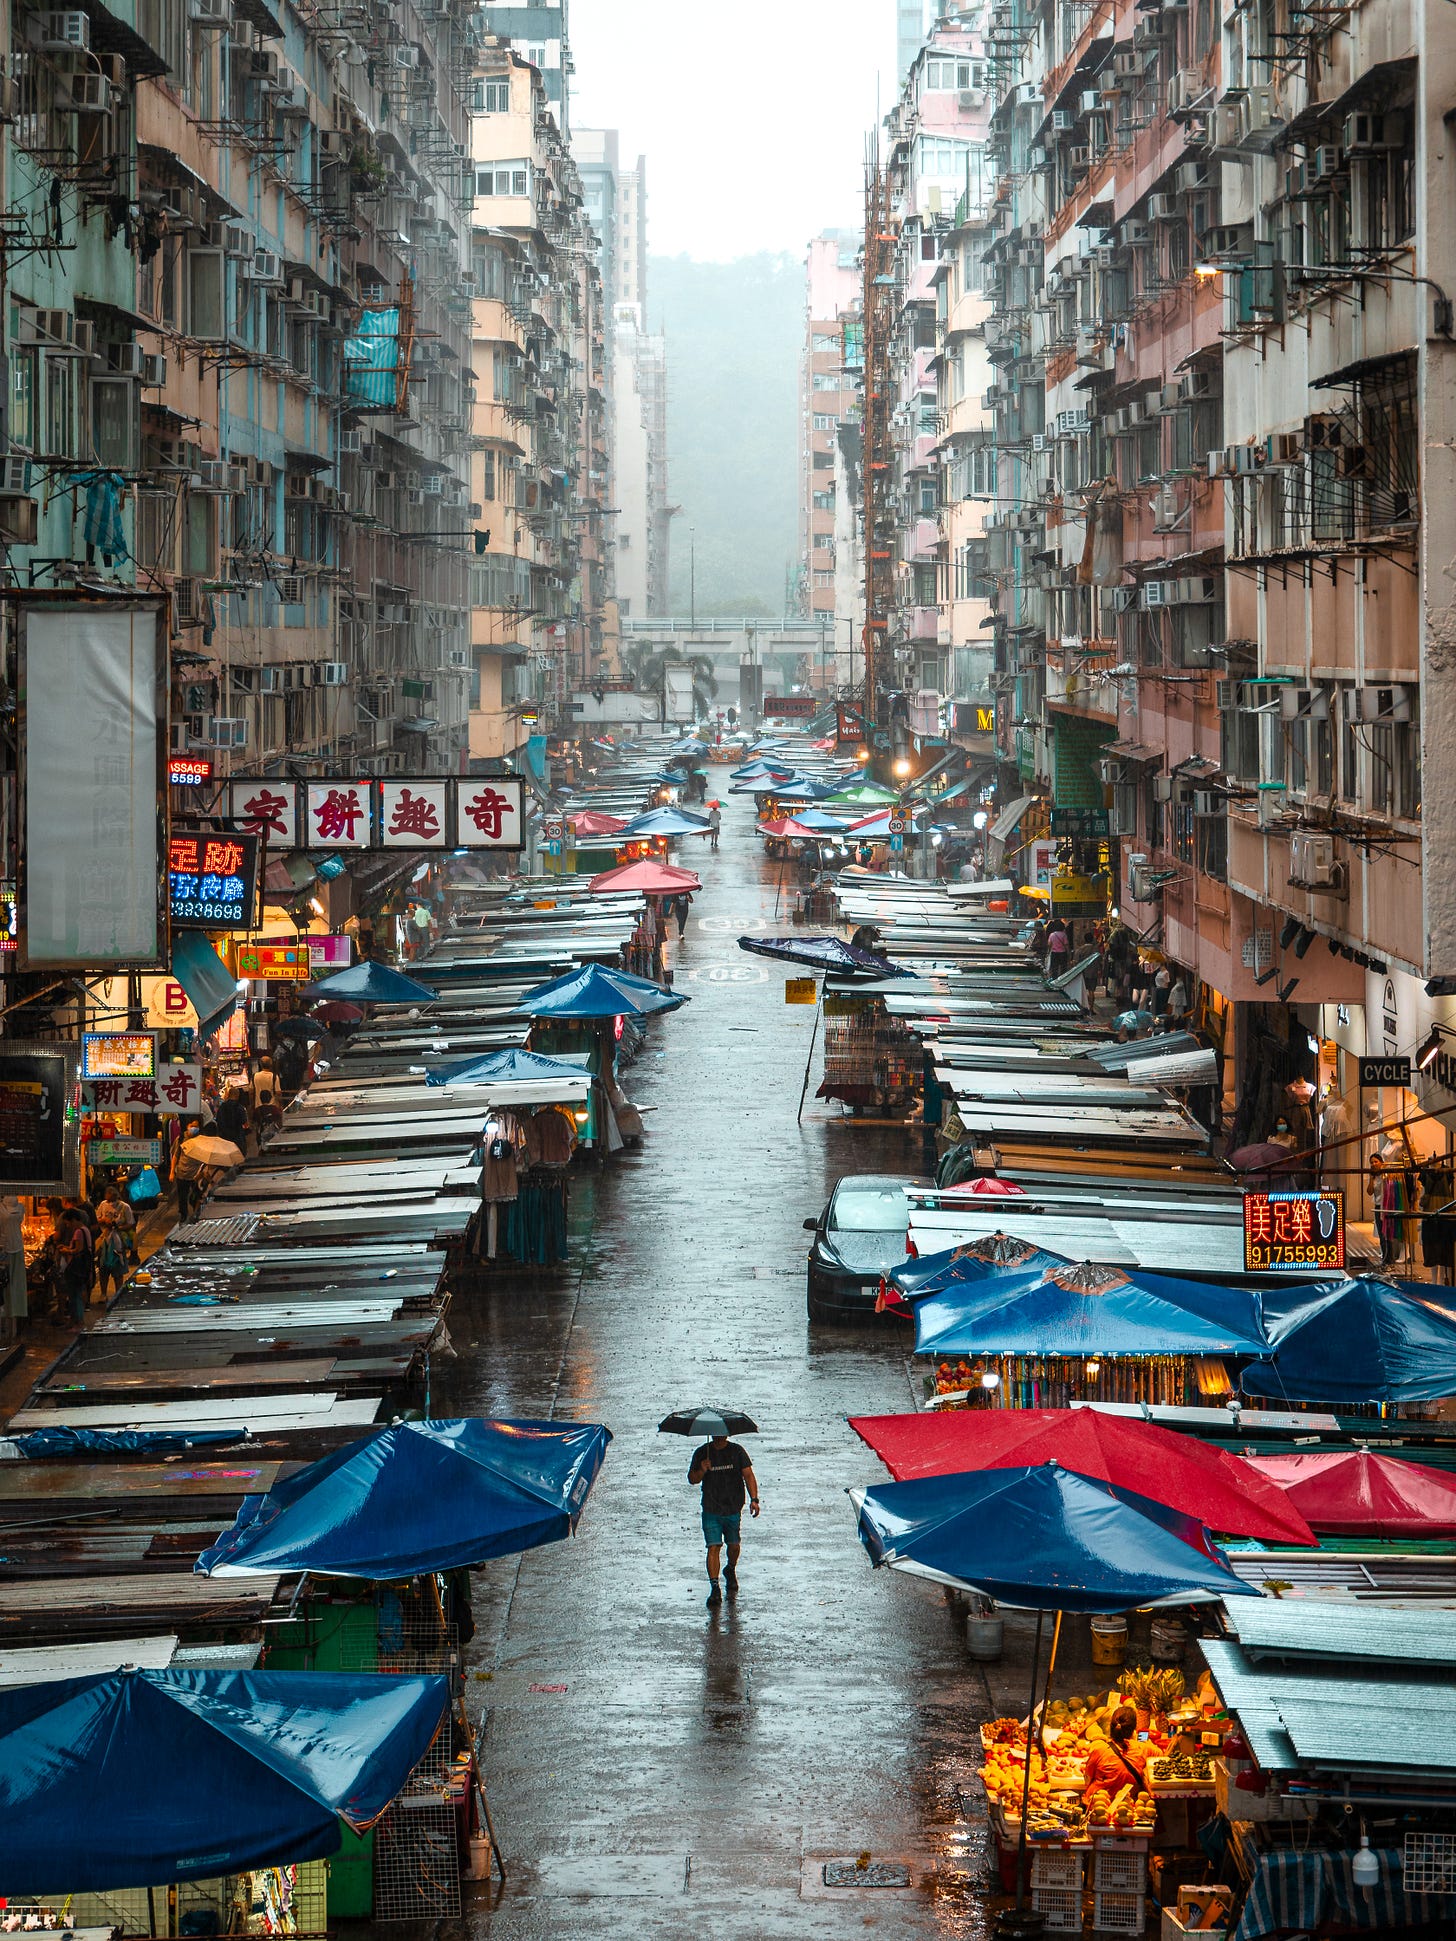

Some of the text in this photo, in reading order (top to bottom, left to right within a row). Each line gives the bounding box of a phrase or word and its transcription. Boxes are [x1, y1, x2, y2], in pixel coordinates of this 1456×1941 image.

[549, 828, 561, 836] 30
[165, 983, 188, 1011] B
[1364, 1064, 1409, 1081] CYCLE
[1251, 1198, 1312, 1244] 美足樂
[1251, 1245, 1338, 1264] 91755993
